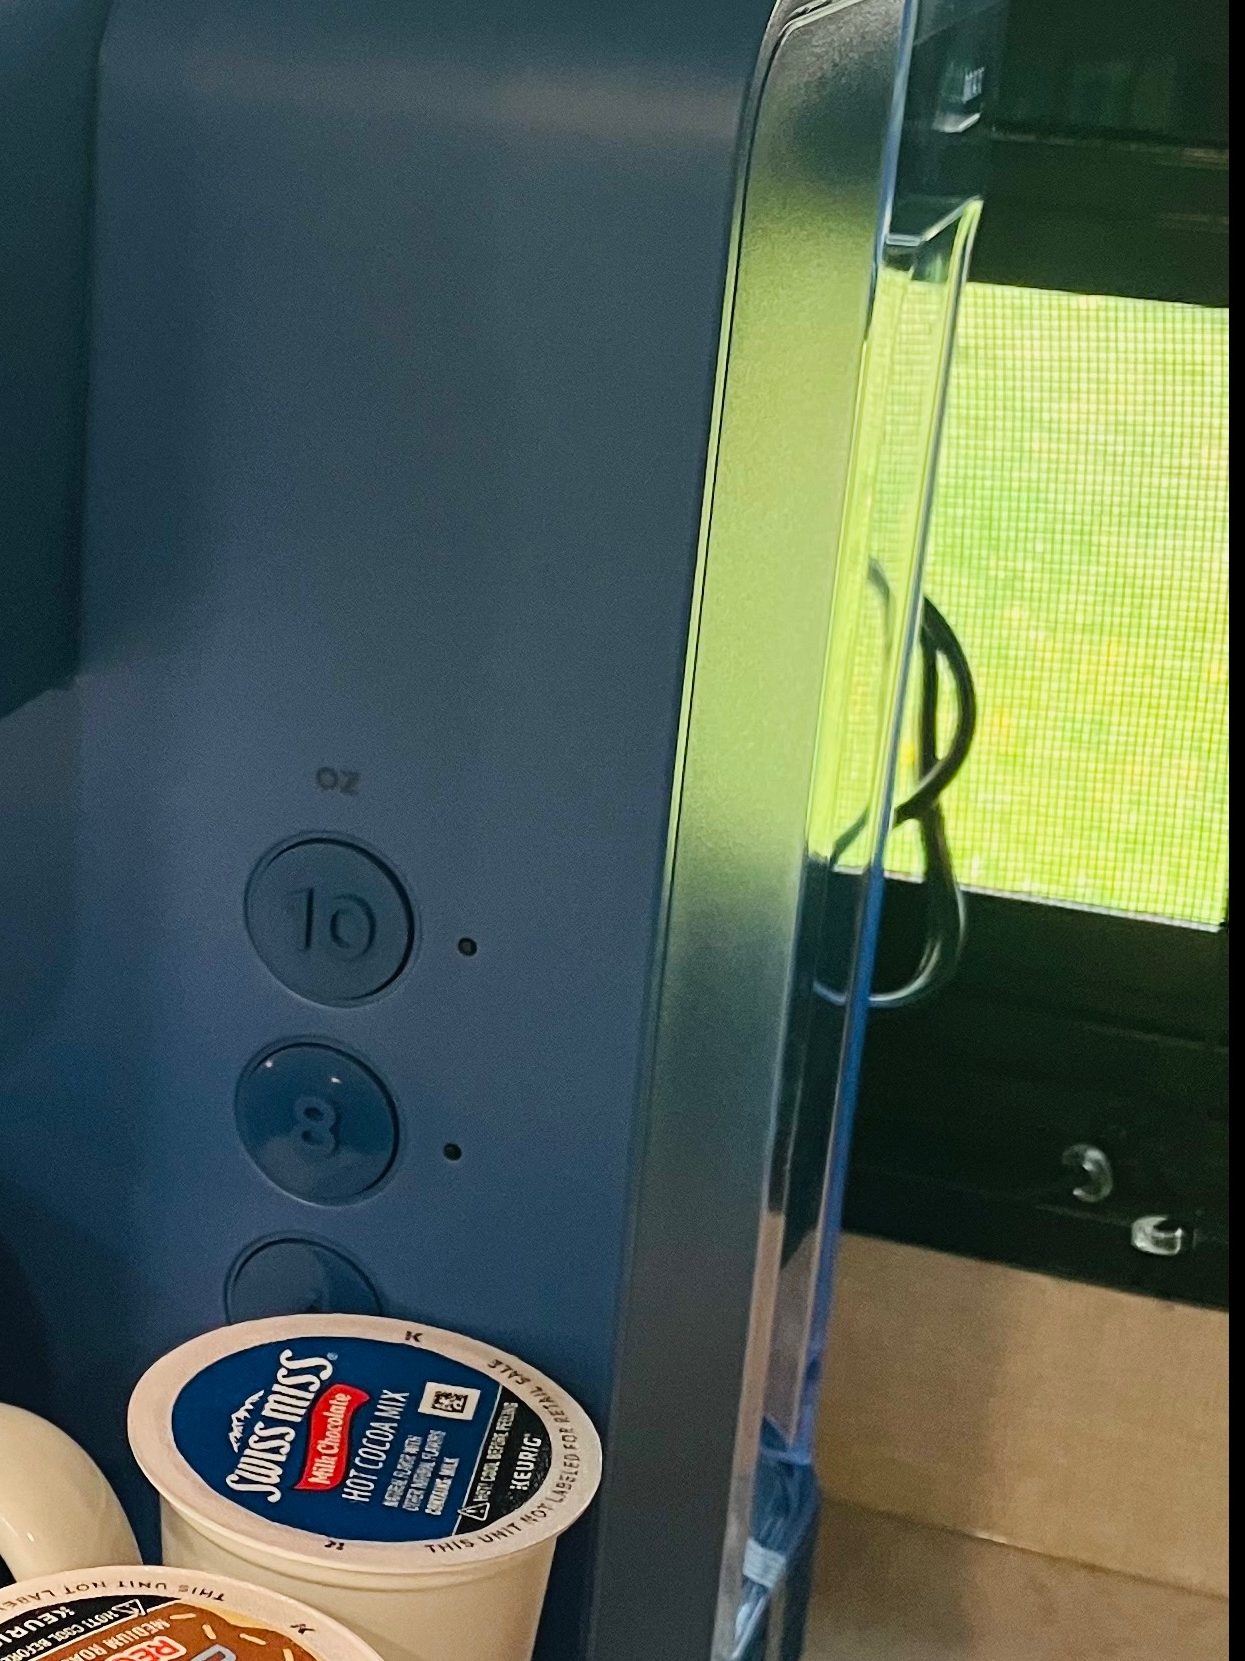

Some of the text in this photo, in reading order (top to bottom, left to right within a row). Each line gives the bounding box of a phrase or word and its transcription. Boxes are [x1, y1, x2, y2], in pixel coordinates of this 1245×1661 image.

[285, 887, 376, 961] 10
[292, 1096, 341, 1158] 8
[226, 1421, 296, 1503] SWISS
[307, 1392, 352, 1485] Milk Chocolate
[342, 1389, 410, 1502] HOT COCOA MIX
[424, 1359, 581, 1553] THIS UNIT NOT LABELED FOR RETAIL SALE
[510, 1437, 542, 1491] KEURIG
[64, 1581, 107, 1595] NOT
[118, 1581, 167, 1589] UNIT
[178, 1584, 226, 1602] THIS
[48, 1624, 85, 1642] COOL
[61, 1619, 171, 1661] MEDIUM ROA
